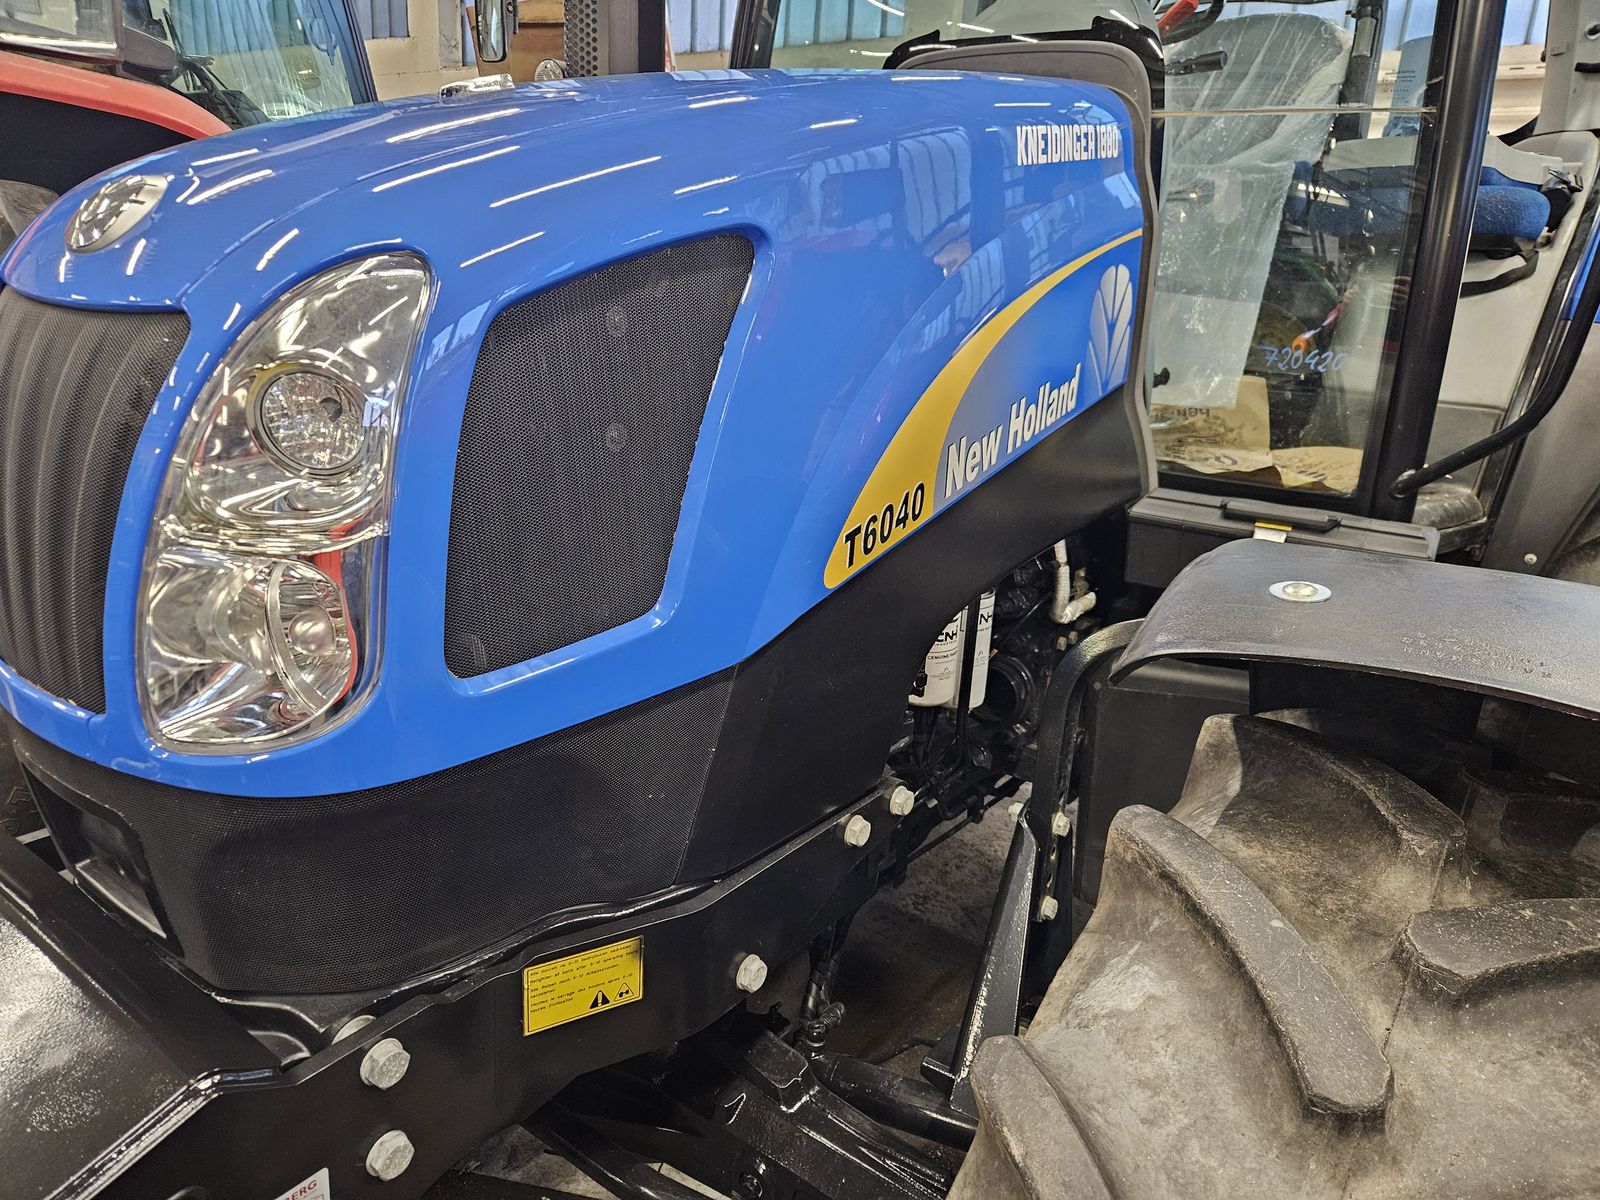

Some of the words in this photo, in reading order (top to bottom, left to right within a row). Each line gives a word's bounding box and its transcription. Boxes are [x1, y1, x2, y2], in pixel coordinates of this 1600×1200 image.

[1016, 124, 1095, 166] KNEIDINGER
[1096, 124, 1119, 159] 1880
[944, 424, 1003, 499] New
[1006, 362, 1082, 455] Holland
[843, 481, 925, 569] T6040
